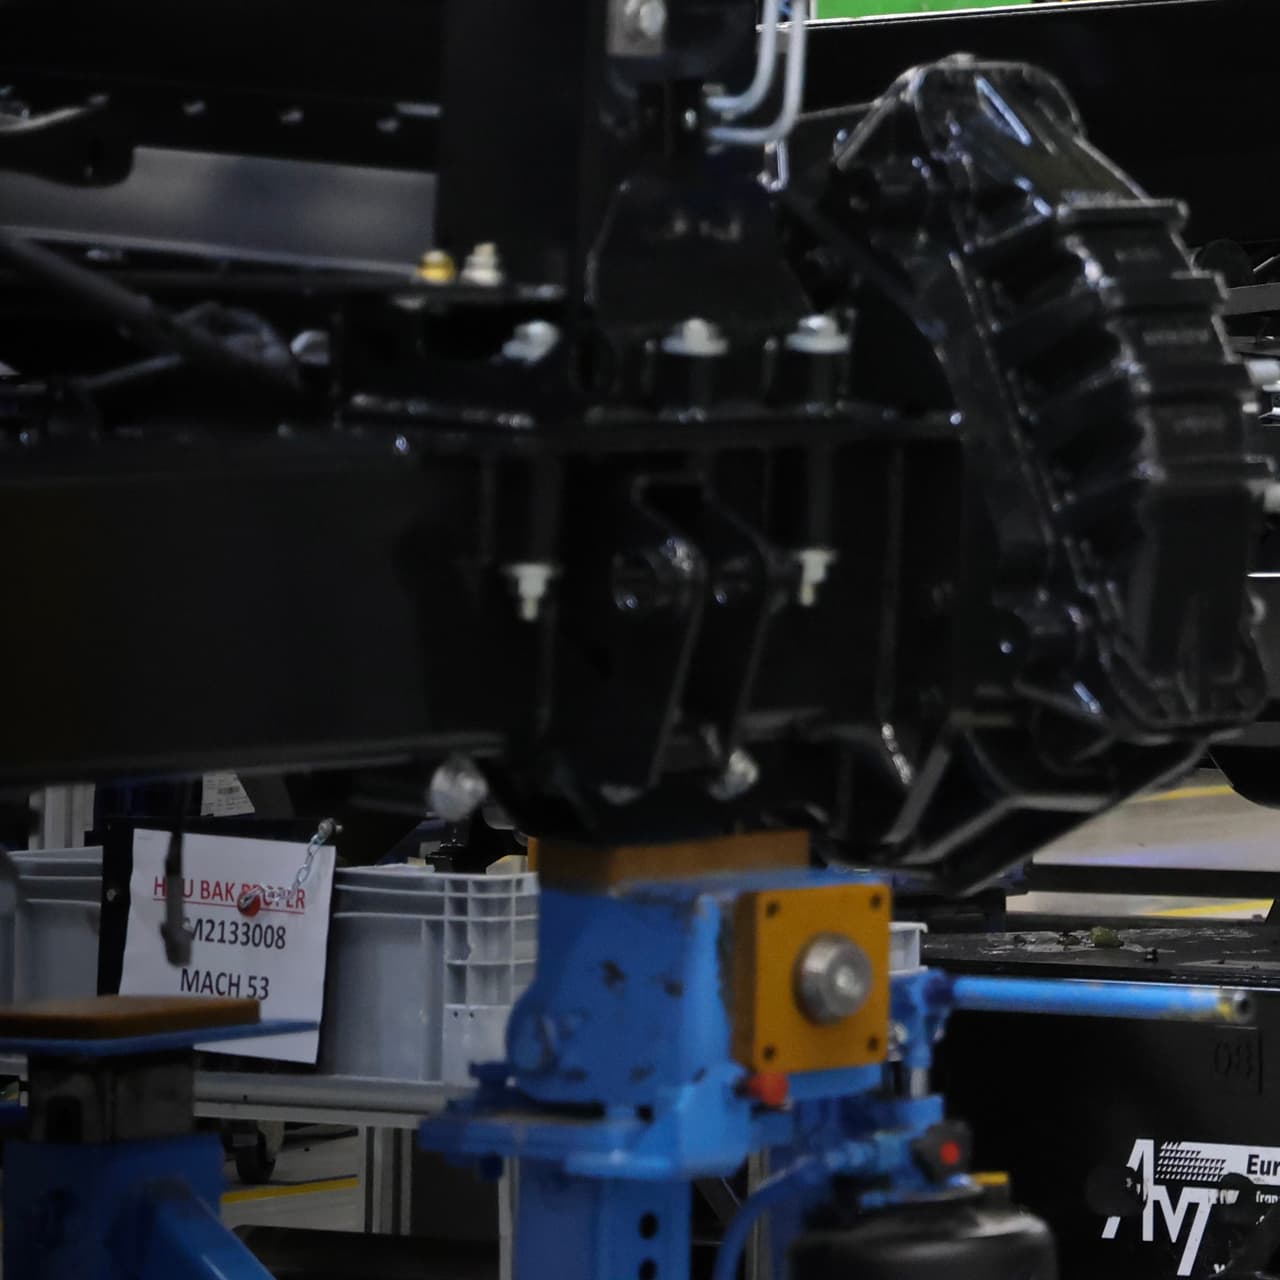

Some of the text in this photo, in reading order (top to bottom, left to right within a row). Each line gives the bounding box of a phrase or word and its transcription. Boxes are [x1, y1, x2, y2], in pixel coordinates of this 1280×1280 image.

[153, 876, 194, 899] HU
[200, 880, 236, 902] BAK
[181, 968, 270, 1000] MACH 53
